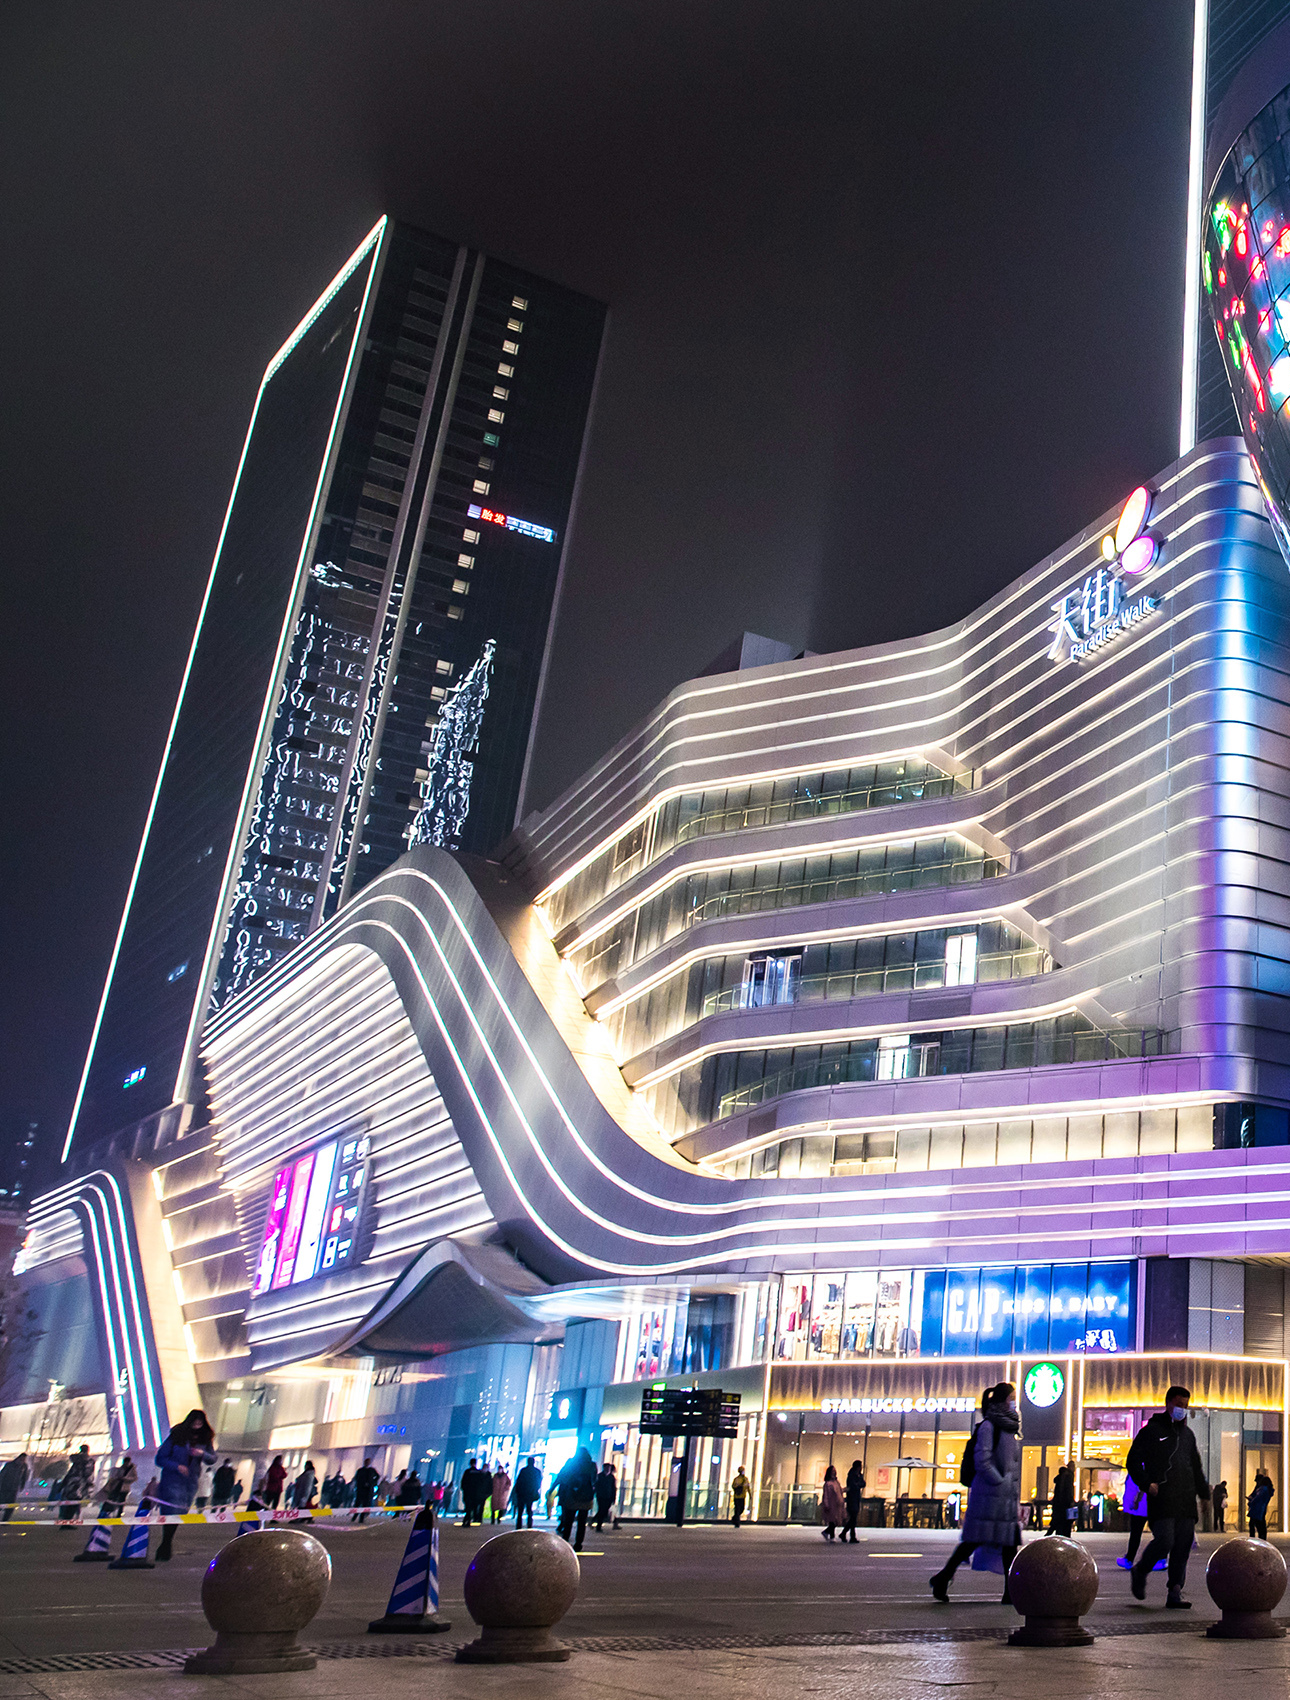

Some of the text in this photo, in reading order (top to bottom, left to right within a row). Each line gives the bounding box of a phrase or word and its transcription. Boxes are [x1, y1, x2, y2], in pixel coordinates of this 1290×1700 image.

[1047, 562, 1123, 660] 天街
[1070, 595, 1156, 660] Paradise Walk
[948, 1287, 1000, 1334] GAP
[1002, 1298, 1045, 1314] KIDS
[1069, 1296, 1118, 1312] BABY
[820, 1397, 976, 1413] STARBUCKS COFFEE
